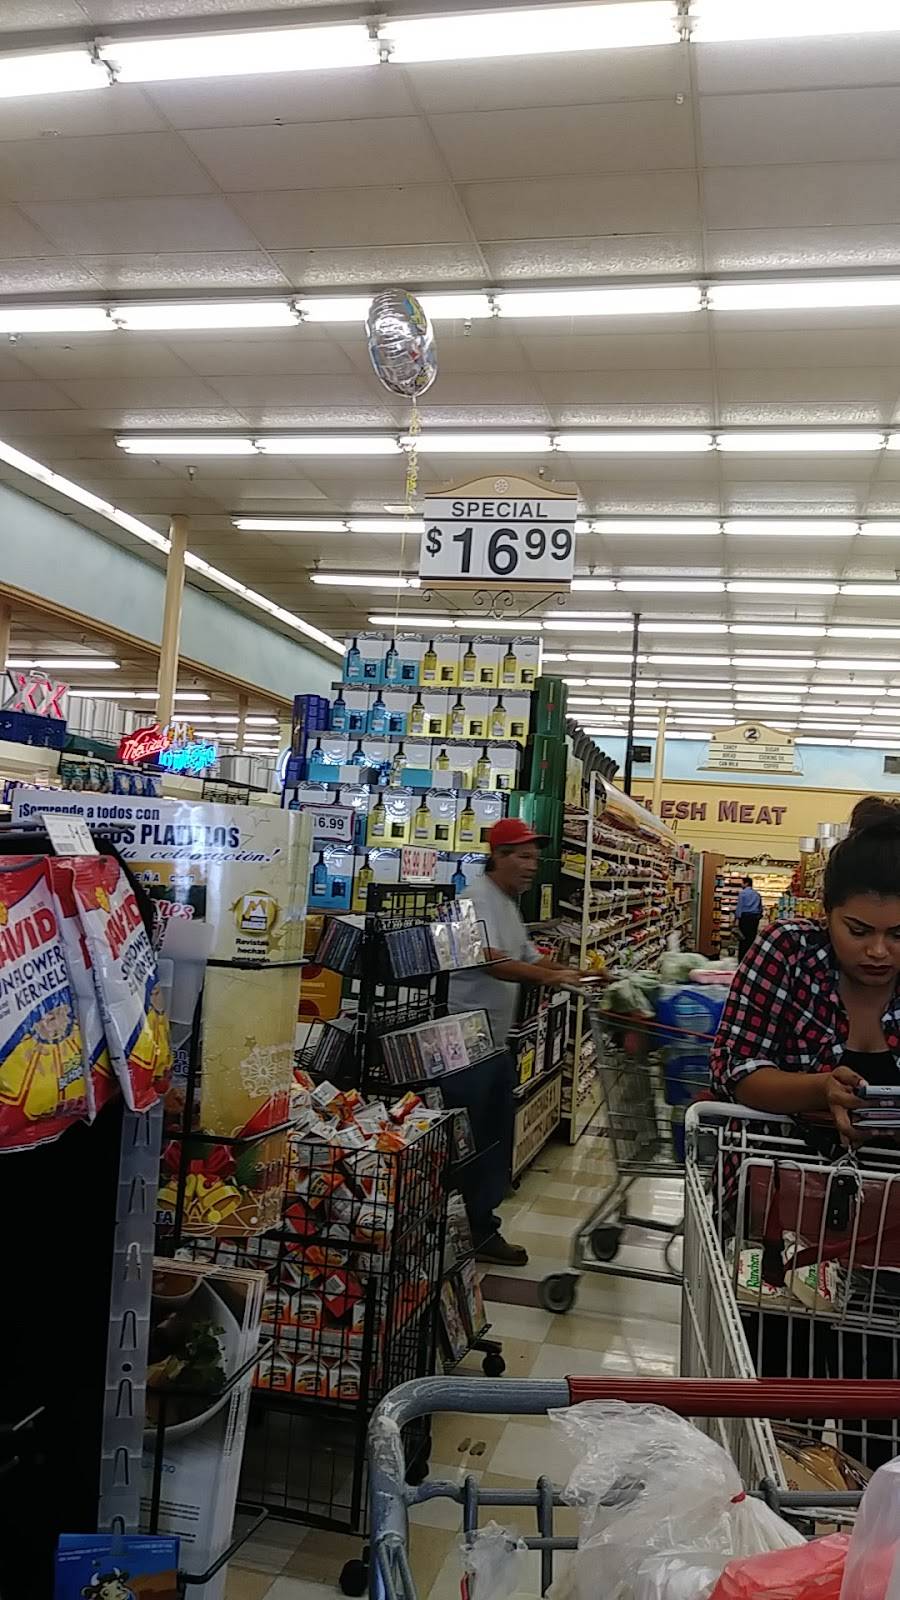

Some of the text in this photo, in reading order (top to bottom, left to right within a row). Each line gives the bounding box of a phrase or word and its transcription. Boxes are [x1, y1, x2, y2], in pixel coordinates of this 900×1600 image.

[451, 502, 548, 518] SPECIAL
[747, 728, 757, 739] 2
[87, 807, 94, 818] a
[97, 806, 132, 819] todos
[136, 808, 160, 819] con
[718, 800, 787, 825] MEAT
[14, 964, 68, 1011] KERNELS
